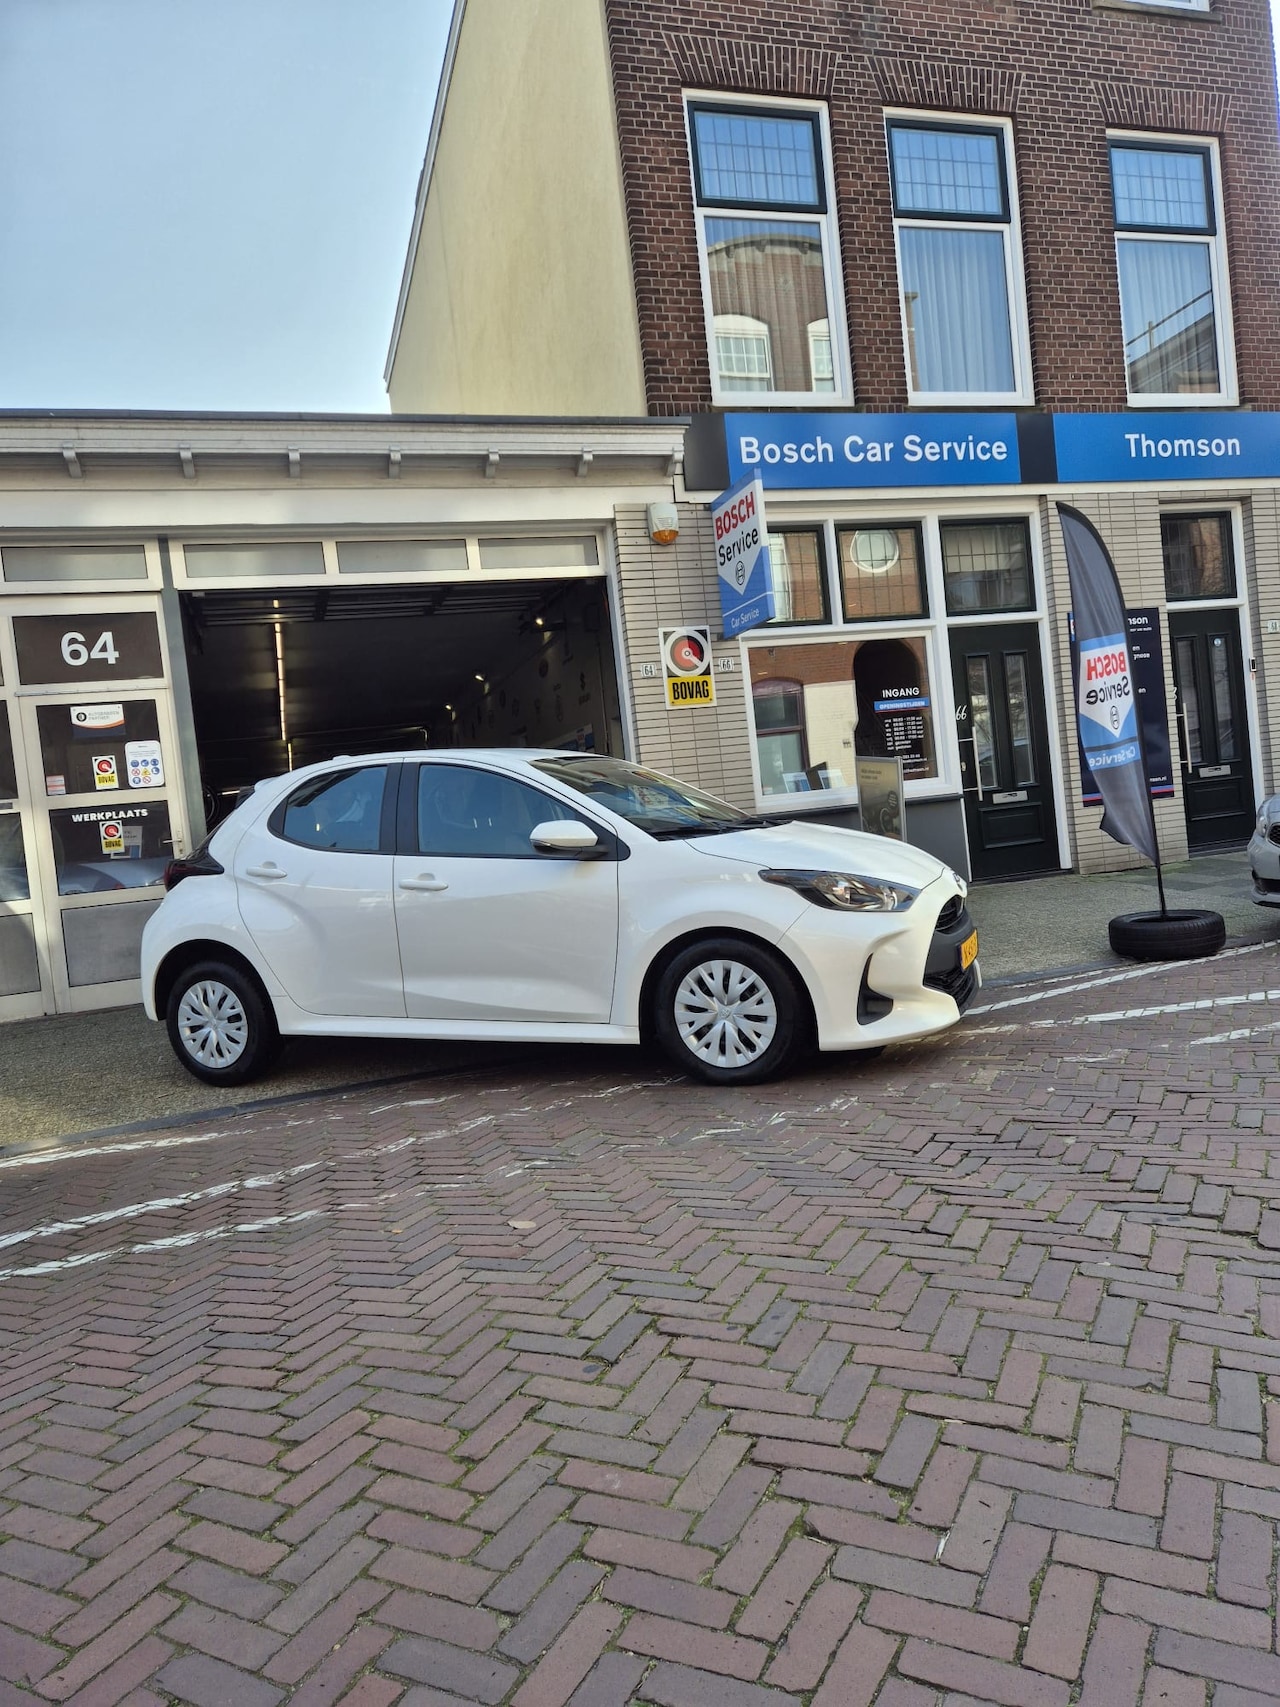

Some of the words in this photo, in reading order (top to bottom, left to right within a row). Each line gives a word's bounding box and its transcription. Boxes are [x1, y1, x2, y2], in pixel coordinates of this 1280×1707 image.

[739, 435, 834, 464] Bosch
[843, 435, 894, 463] Car
[903, 434, 1008, 462] Service
[1124, 433, 1241, 458] Thomson
[715, 491, 756, 541] BOSCH
[718, 527, 760, 567] Service
[730, 616, 741, 629] Car
[740, 608, 760, 625] Service
[61, 631, 120, 666] 64
[644, 665, 654, 676] 64
[722, 659, 731, 671] 66
[672, 680, 710, 700] BOVAG
[882, 687, 920, 698] INGANG
[956, 705, 967, 720] 66
[98, 775, 115, 784] BOVAG
[72, 809, 148, 822] WERKPLAATS
[105, 839, 122, 849] BOVAG
